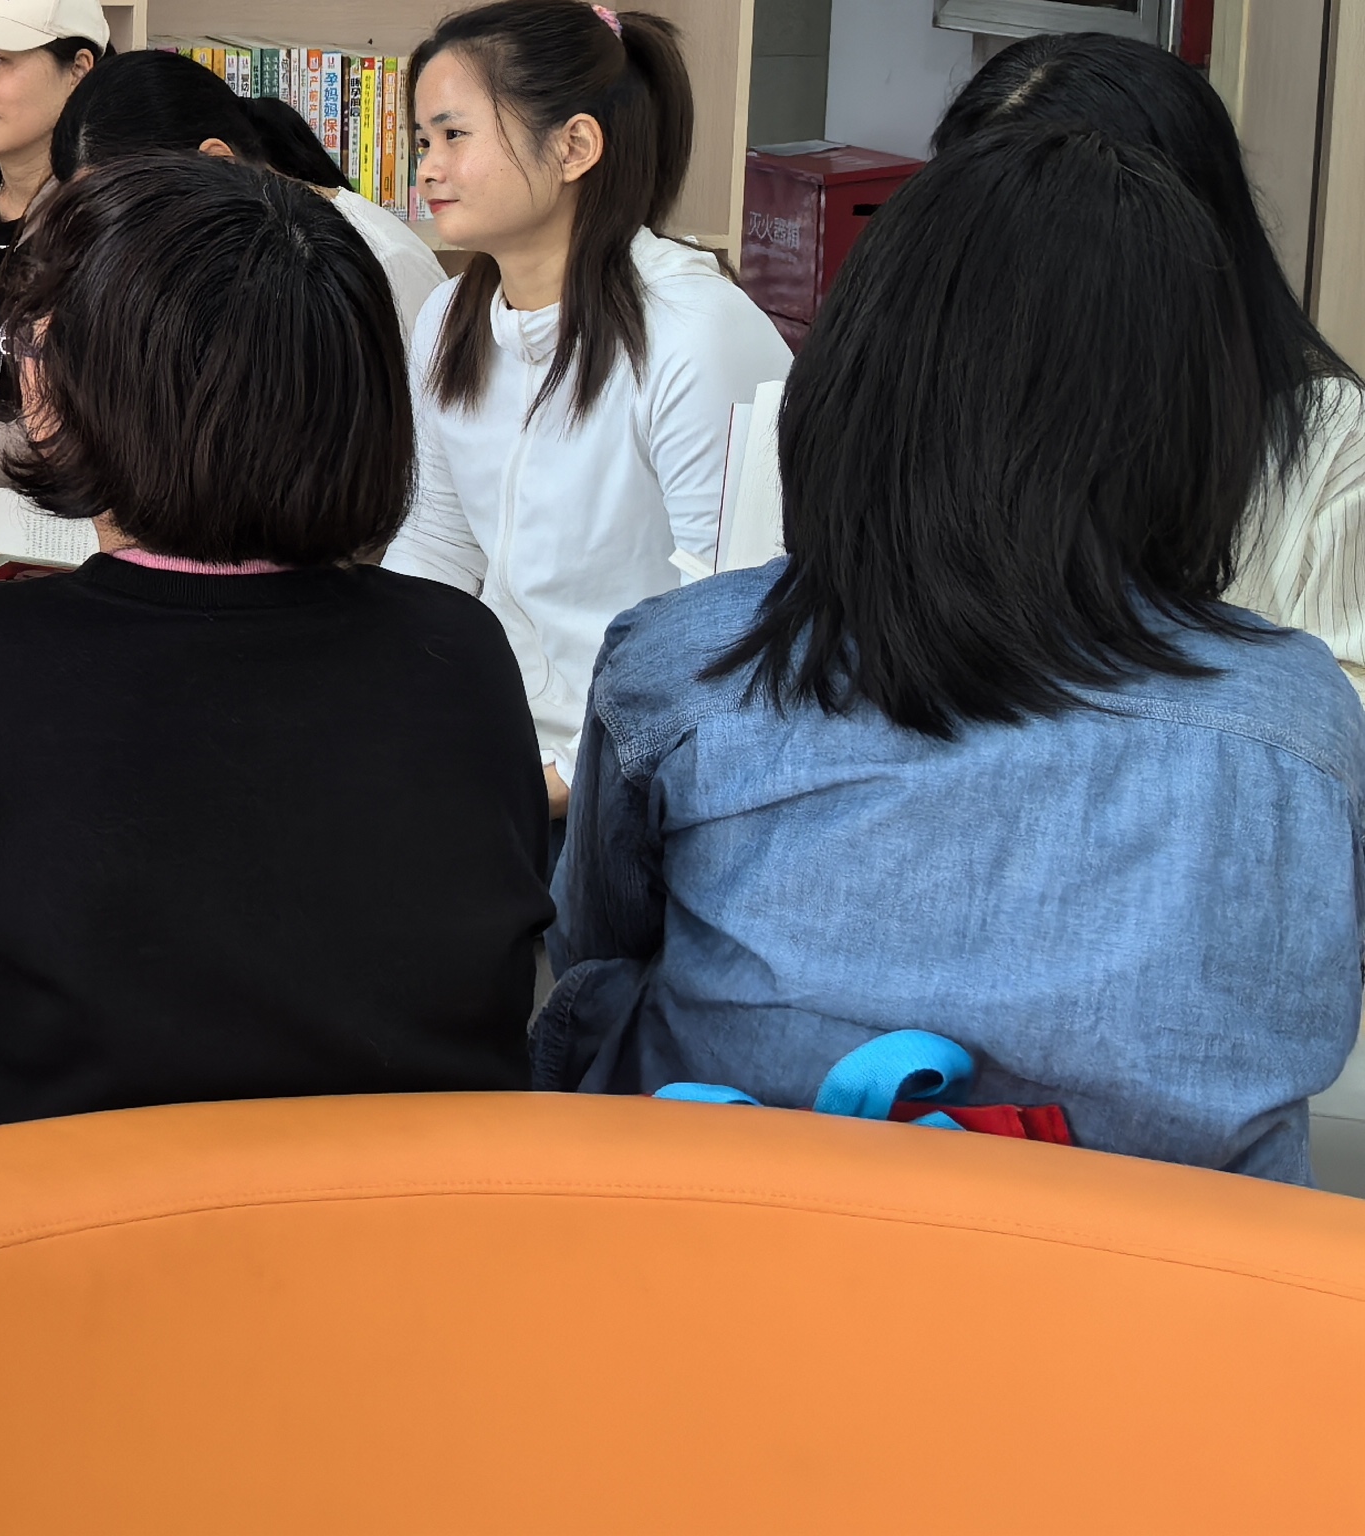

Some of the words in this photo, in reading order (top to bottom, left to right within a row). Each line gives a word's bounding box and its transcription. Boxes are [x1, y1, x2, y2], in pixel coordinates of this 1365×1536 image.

[323, 72, 339, 149] 孕妈妈保健
